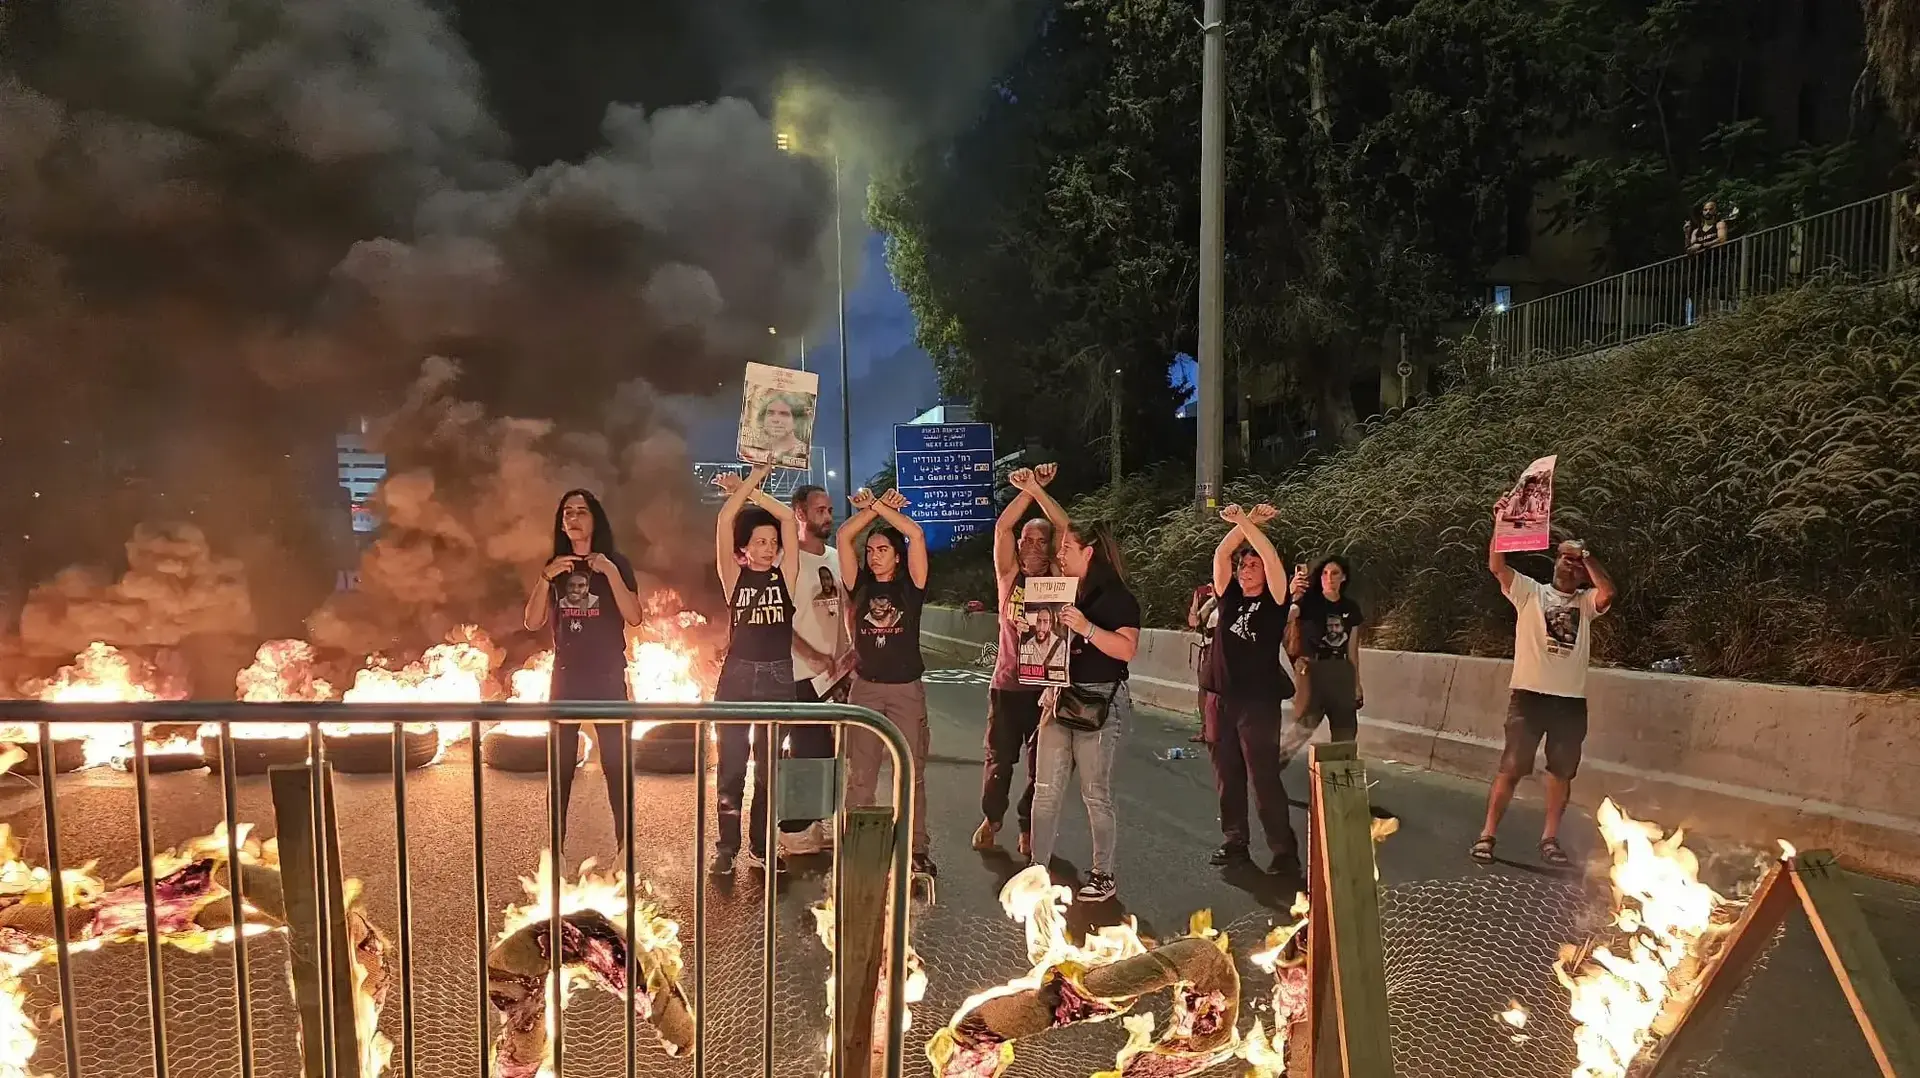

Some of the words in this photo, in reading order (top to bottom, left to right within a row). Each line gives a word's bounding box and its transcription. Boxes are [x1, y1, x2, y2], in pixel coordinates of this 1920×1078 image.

[944, 454, 955, 463] לה
[951, 490, 973, 499] קיבוץ
[941, 509, 973, 518] Galuyot
[953, 524, 974, 533] חולון
